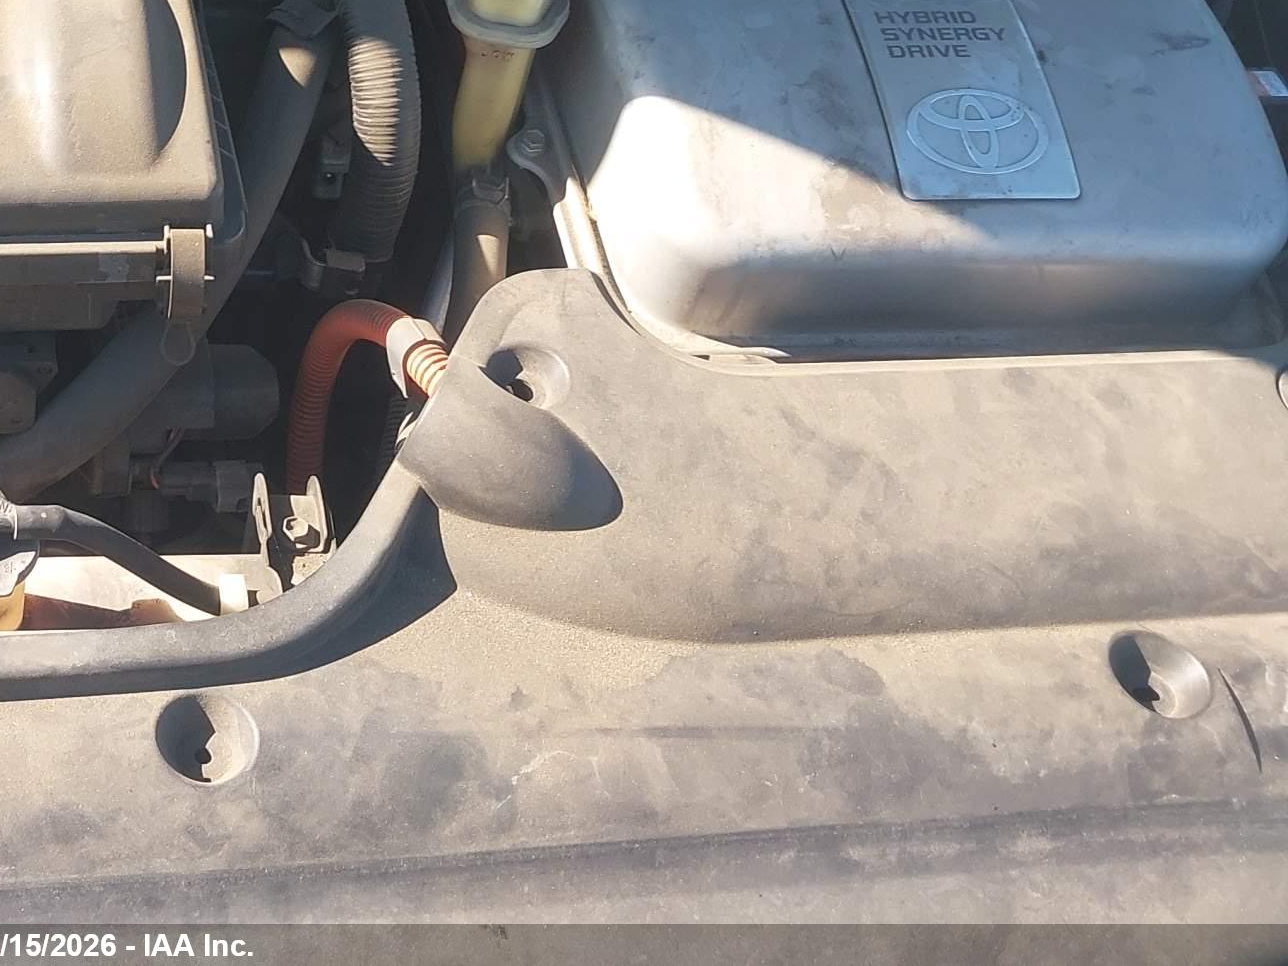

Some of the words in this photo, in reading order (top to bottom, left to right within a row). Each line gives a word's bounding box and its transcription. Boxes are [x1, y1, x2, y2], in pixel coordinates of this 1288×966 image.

[874, 11, 977, 24] HYBRID
[880, 28, 1005, 41] SYNERGY
[887, 45, 971, 58] DRIVE
